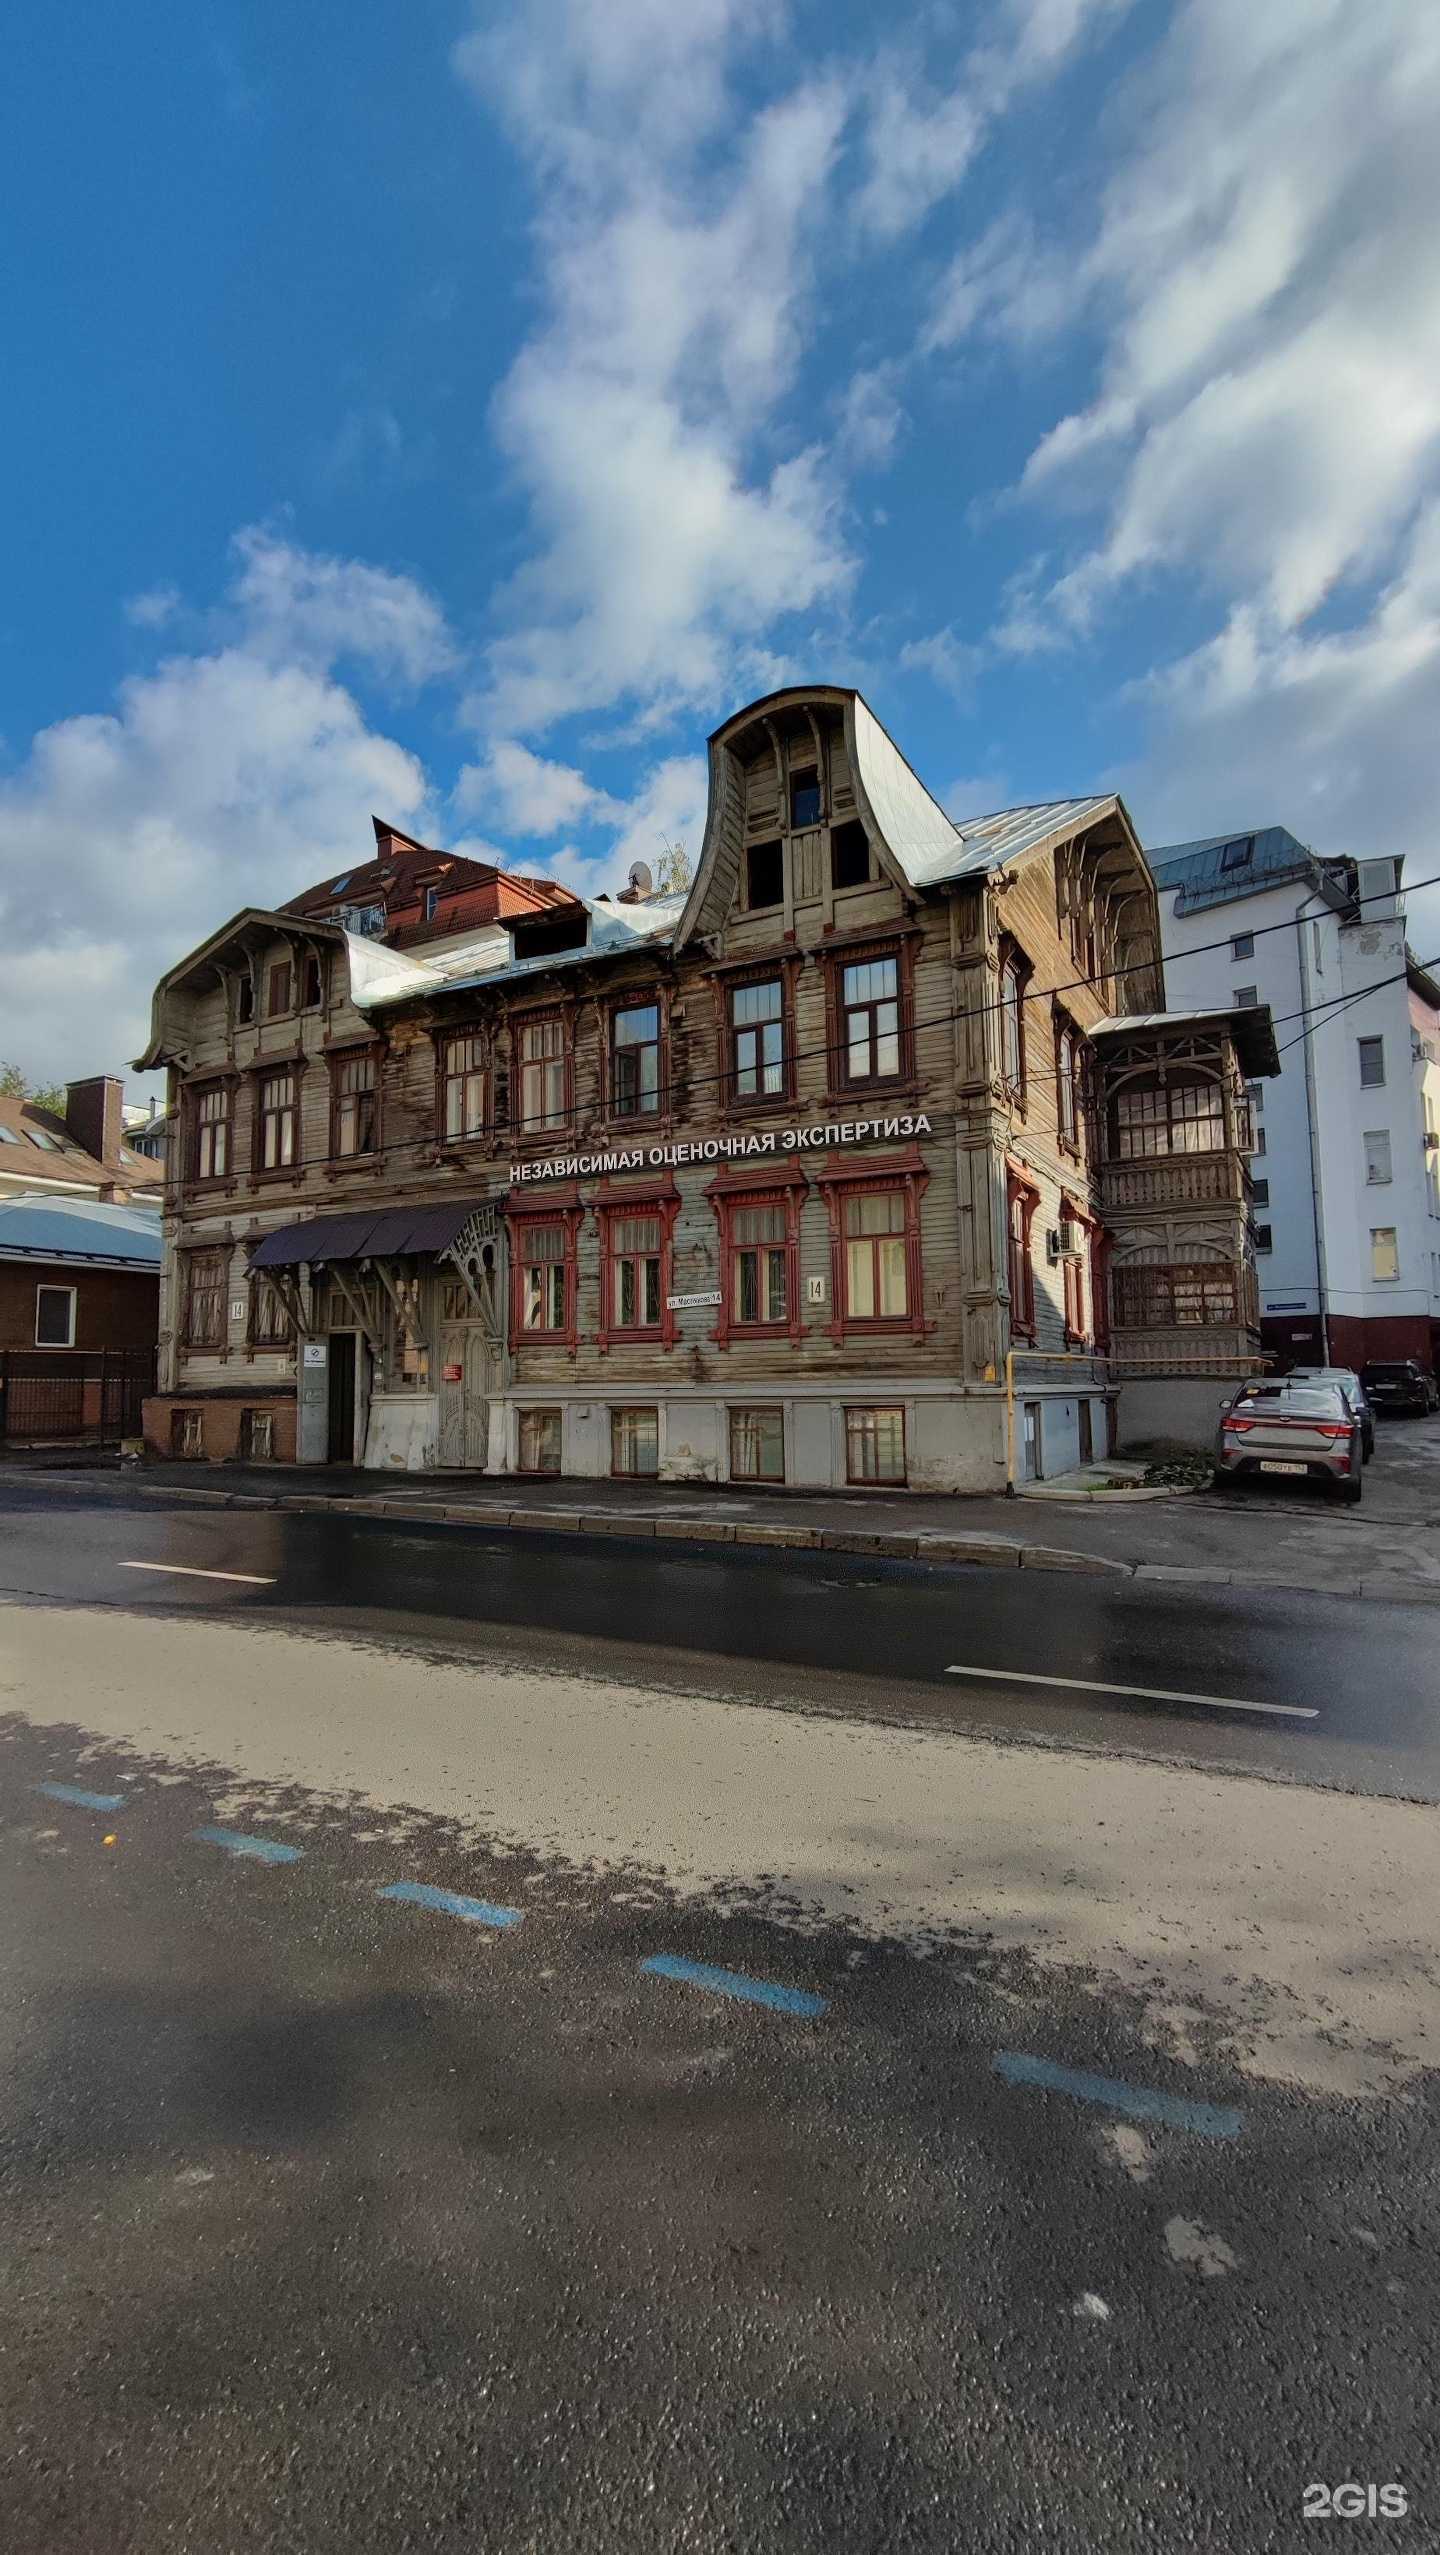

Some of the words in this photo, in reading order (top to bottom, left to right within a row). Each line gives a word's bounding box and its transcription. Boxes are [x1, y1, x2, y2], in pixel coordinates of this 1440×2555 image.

[509, 1149, 644, 1182] НЕЗАВИСИМАЯ
[649, 1132, 775, 1166] ОЦЕНОЧНАЯ
[781, 1113, 932, 1149] ЭКСПЕРТИЗА
[810, 1280, 821, 1298] 14
[234, 1303, 242, 1318] 14
